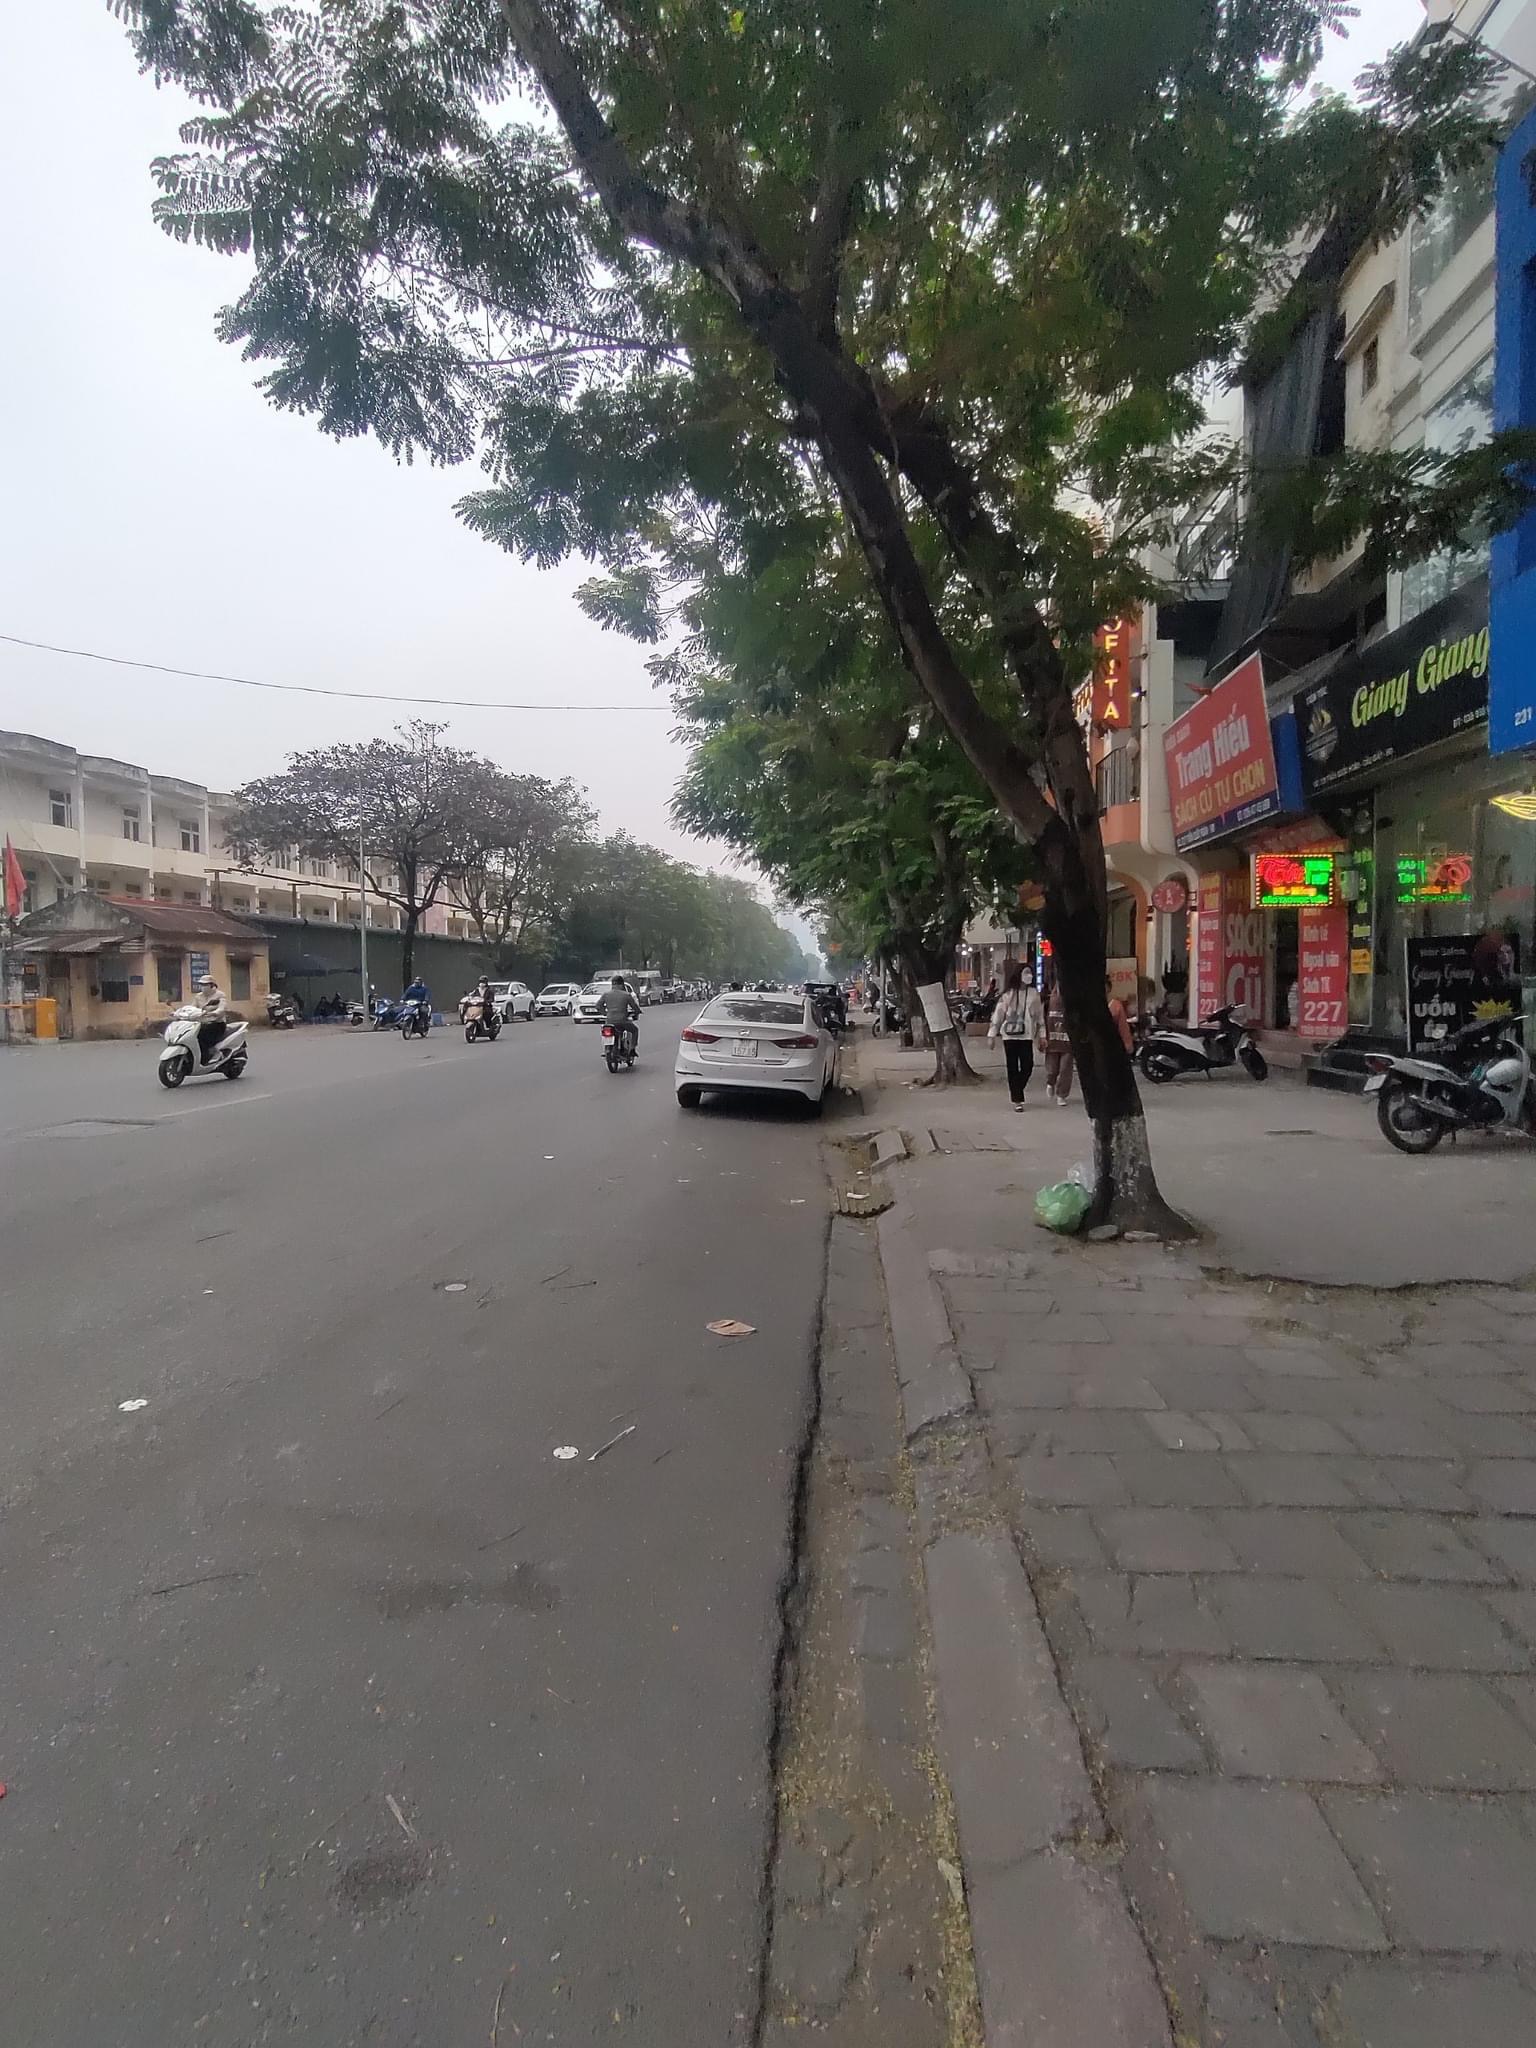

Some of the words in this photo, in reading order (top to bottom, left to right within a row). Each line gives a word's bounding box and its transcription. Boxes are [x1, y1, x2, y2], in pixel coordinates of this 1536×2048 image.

[1352, 668, 1410, 728] Giang
[1416, 626, 1490, 695] Giang
[1175, 740, 1213, 789] Trang
[1212, 703, 1250, 767] Hiếu
[1304, 1001, 1342, 1022] 227
[1414, 993, 1456, 1017] UỐN
